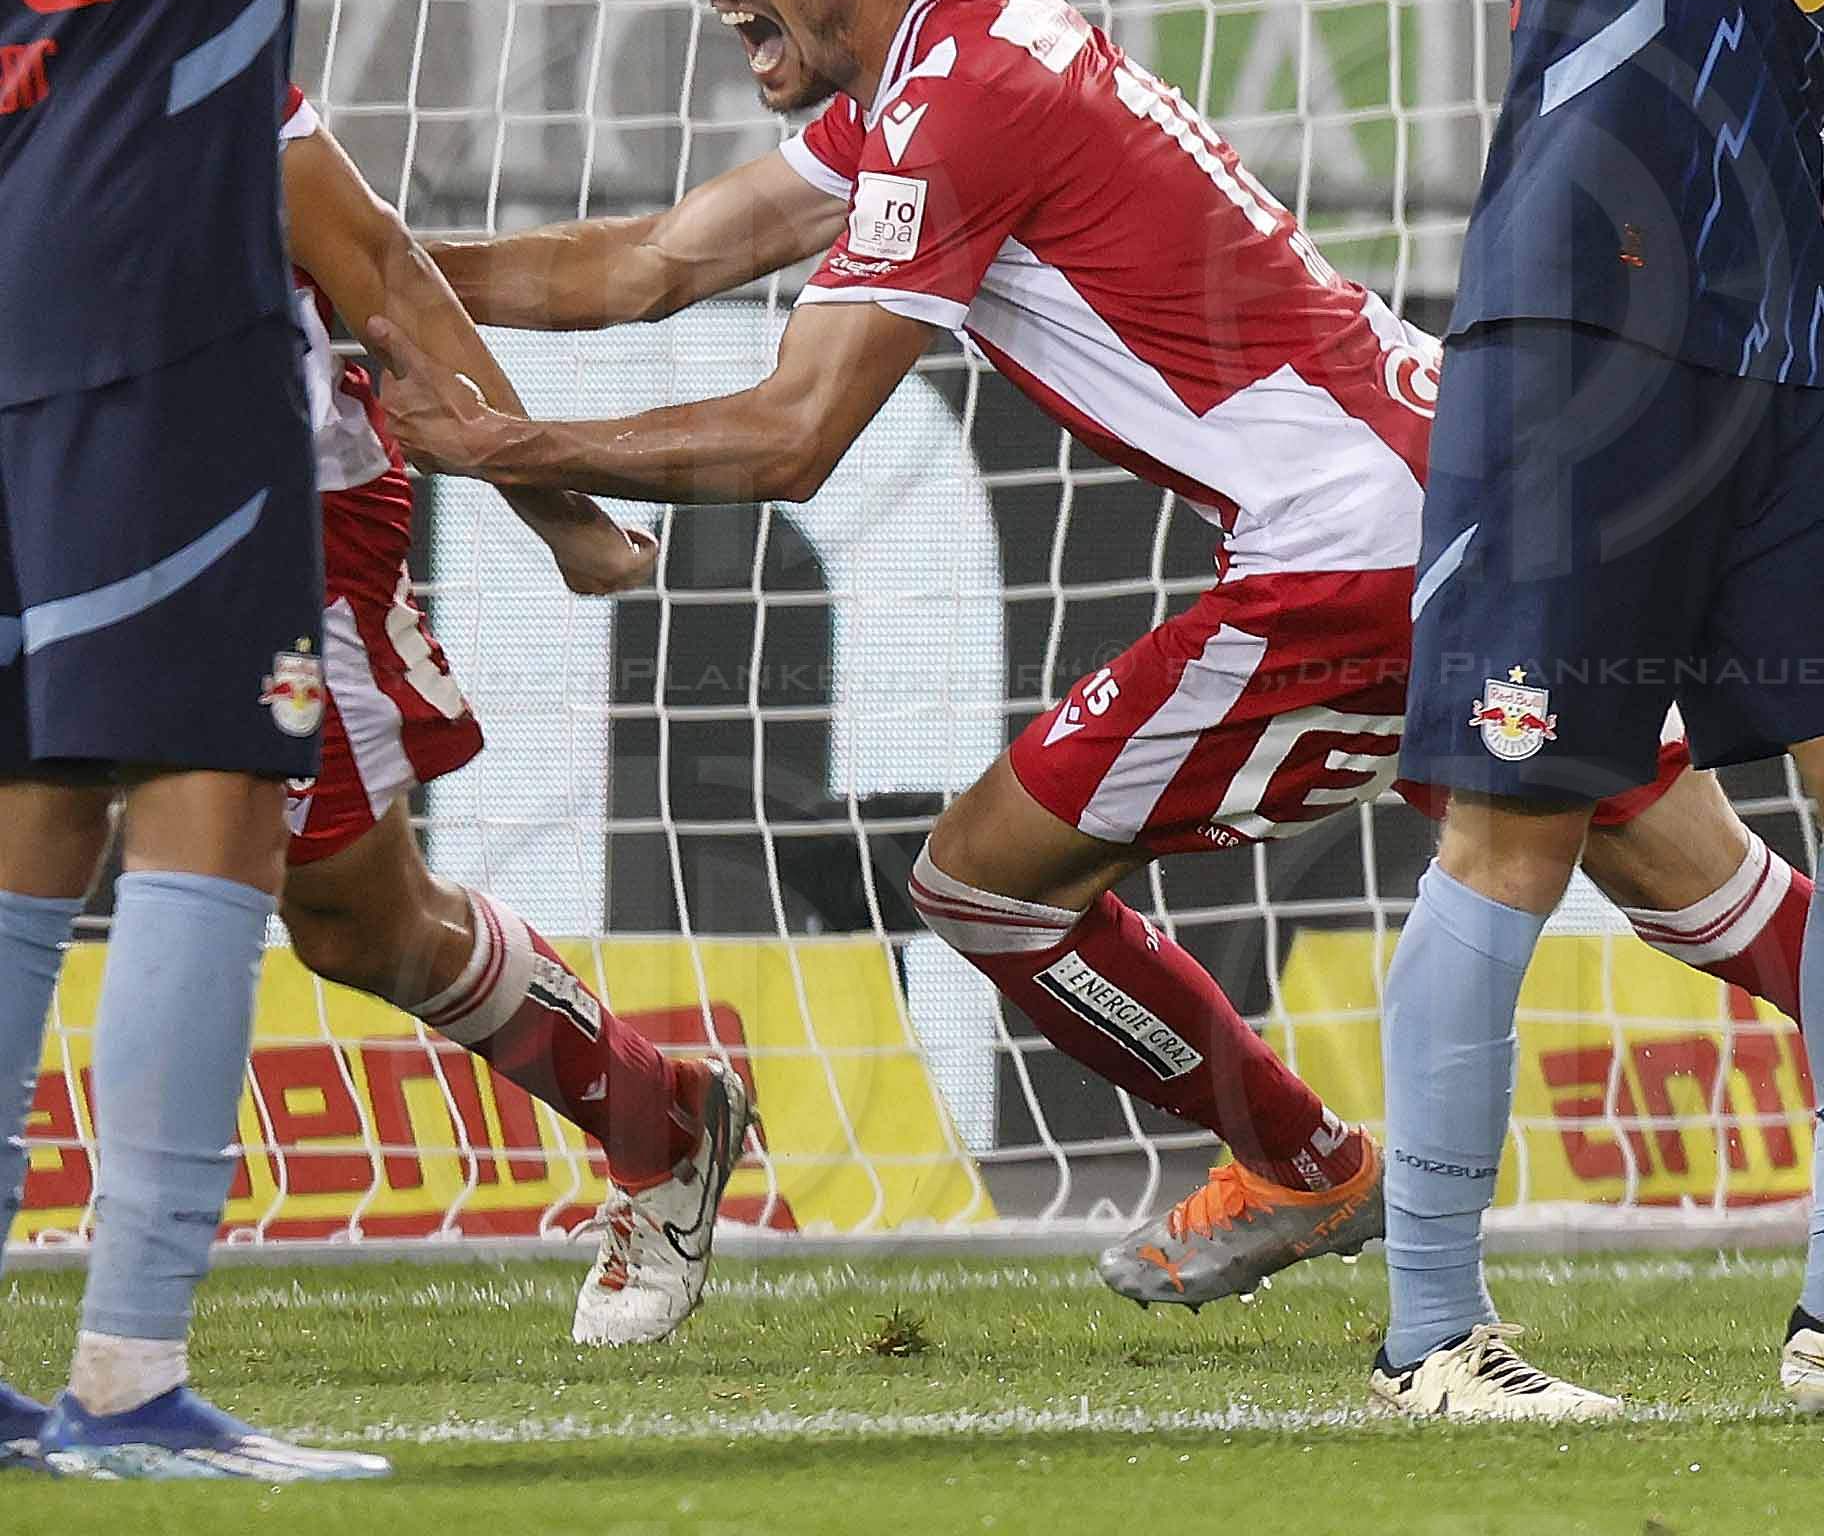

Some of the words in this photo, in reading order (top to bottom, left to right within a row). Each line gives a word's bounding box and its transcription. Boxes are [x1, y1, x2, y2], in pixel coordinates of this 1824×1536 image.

[1081, 667, 1120, 716] 15
[1068, 967, 1155, 1034] ENERGIE
[1147, 1023, 1202, 1071] GRAZ
